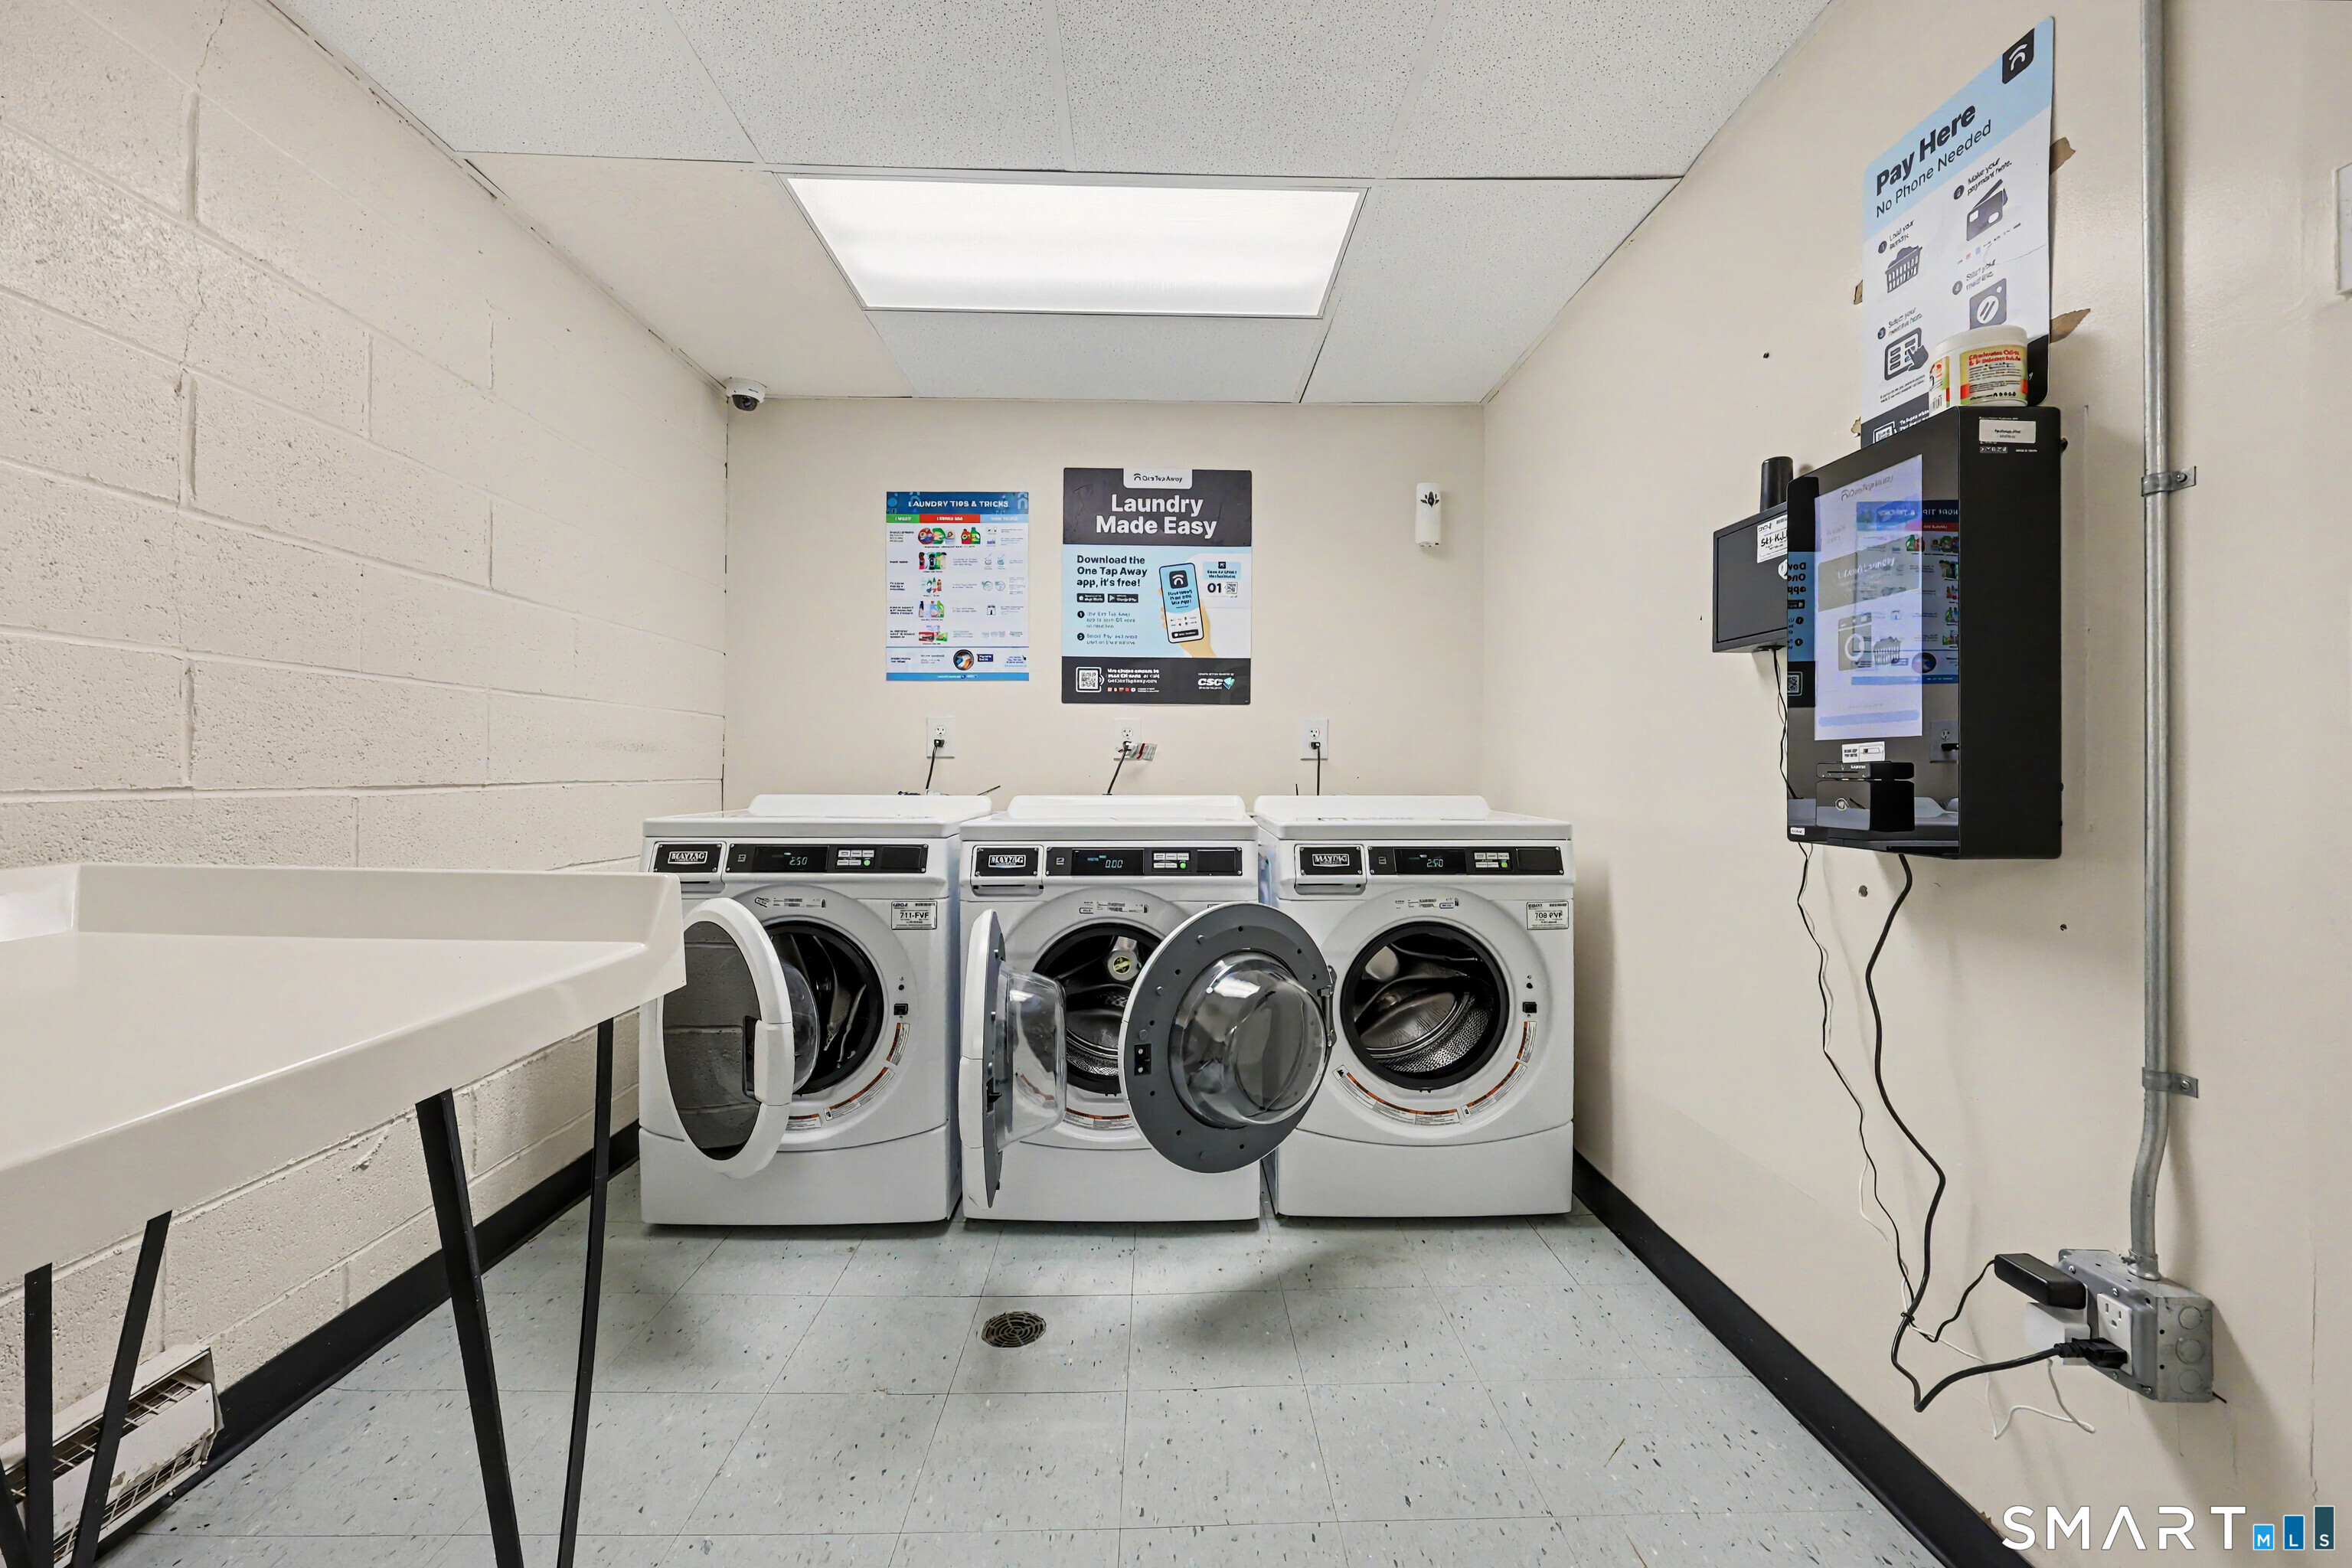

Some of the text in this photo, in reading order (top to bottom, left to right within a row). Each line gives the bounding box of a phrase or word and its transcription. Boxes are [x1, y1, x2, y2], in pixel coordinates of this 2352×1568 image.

[1877, 105, 1975, 196] Pay Here
[1877, 119, 1991, 217] No Phone Needed
[1112, 494, 1204, 517] Laundry
[1096, 515, 1217, 539] Made Easy
[1077, 555, 1145, 564] Download the
[1077, 567, 1148, 577] One Tap Away
[1077, 578, 1141, 588] app, it's free!
[1207, 583, 1222, 593] 01
[1198, 678, 1223, 686] CSC
